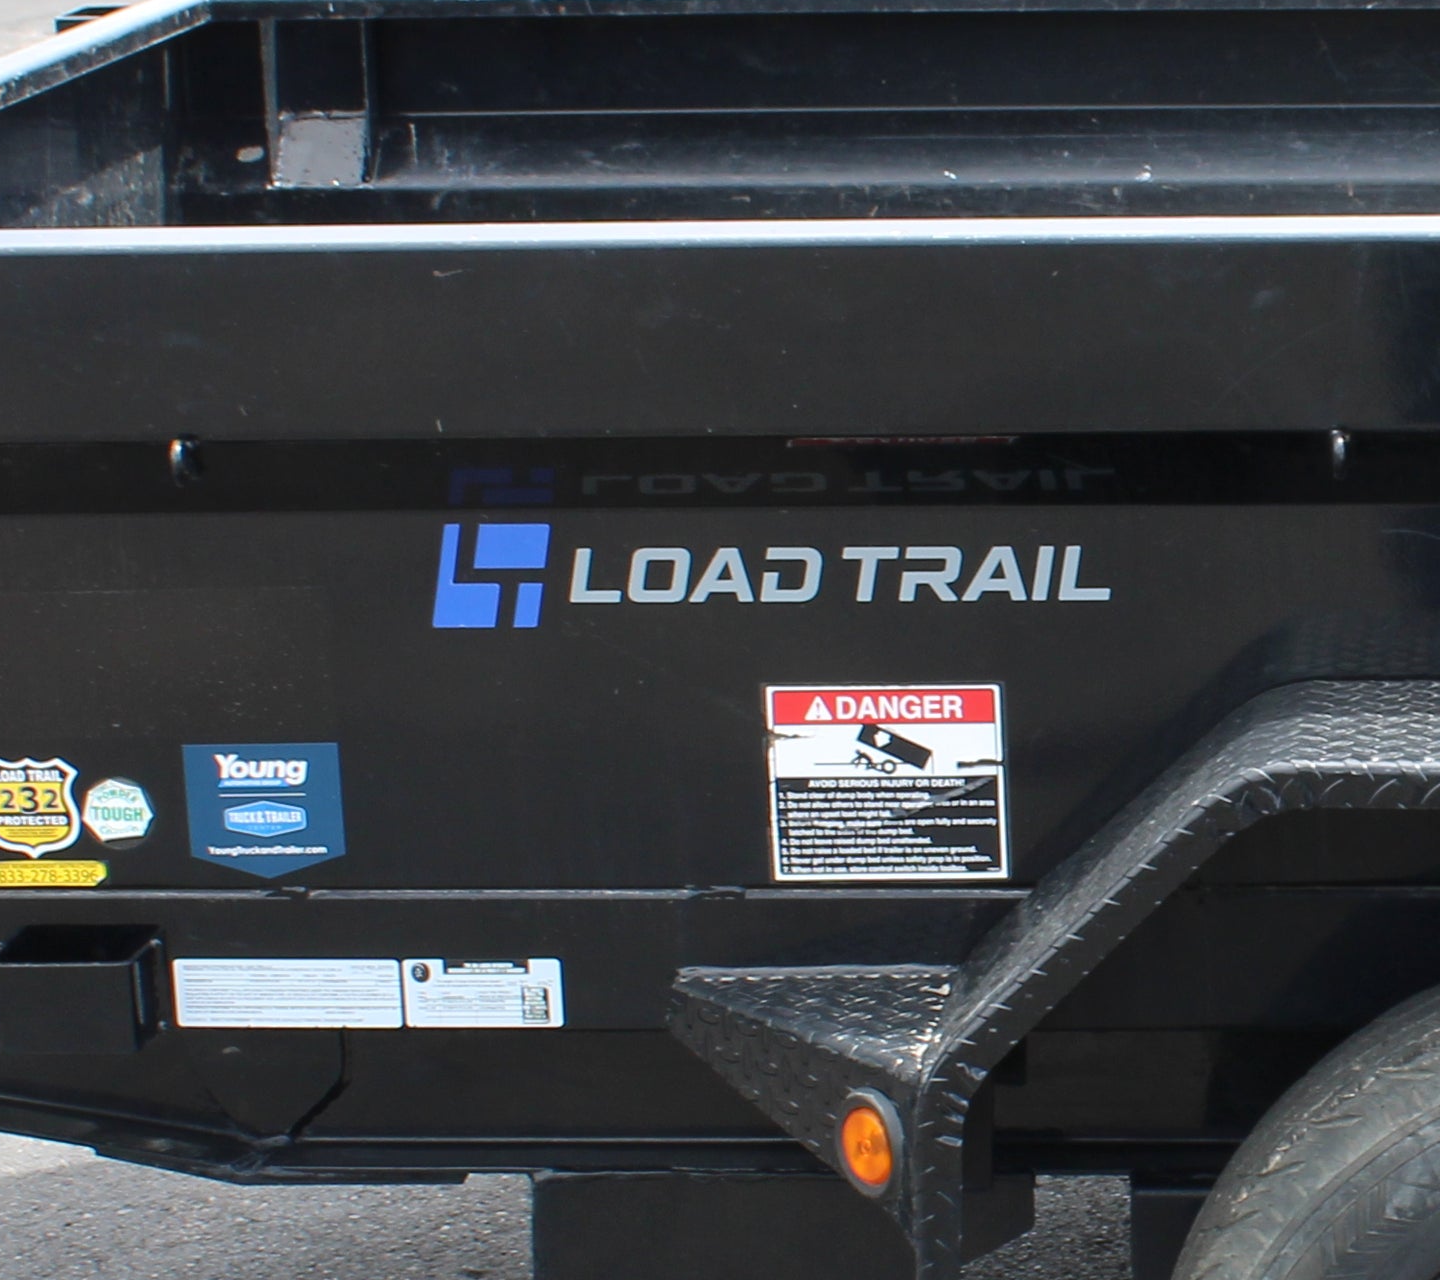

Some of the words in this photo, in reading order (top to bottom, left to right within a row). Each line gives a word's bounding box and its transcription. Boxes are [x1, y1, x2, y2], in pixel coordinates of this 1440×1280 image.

[569, 547, 824, 604] LOAD
[841, 545, 1111, 602] TRAIL
[835, 694, 964, 720] DANGER
[28, 769, 64, 782] TRAIL
[213, 753, 308, 786] Young
[0, 786, 59, 813] 232
[90, 805, 144, 822] TOUGH
